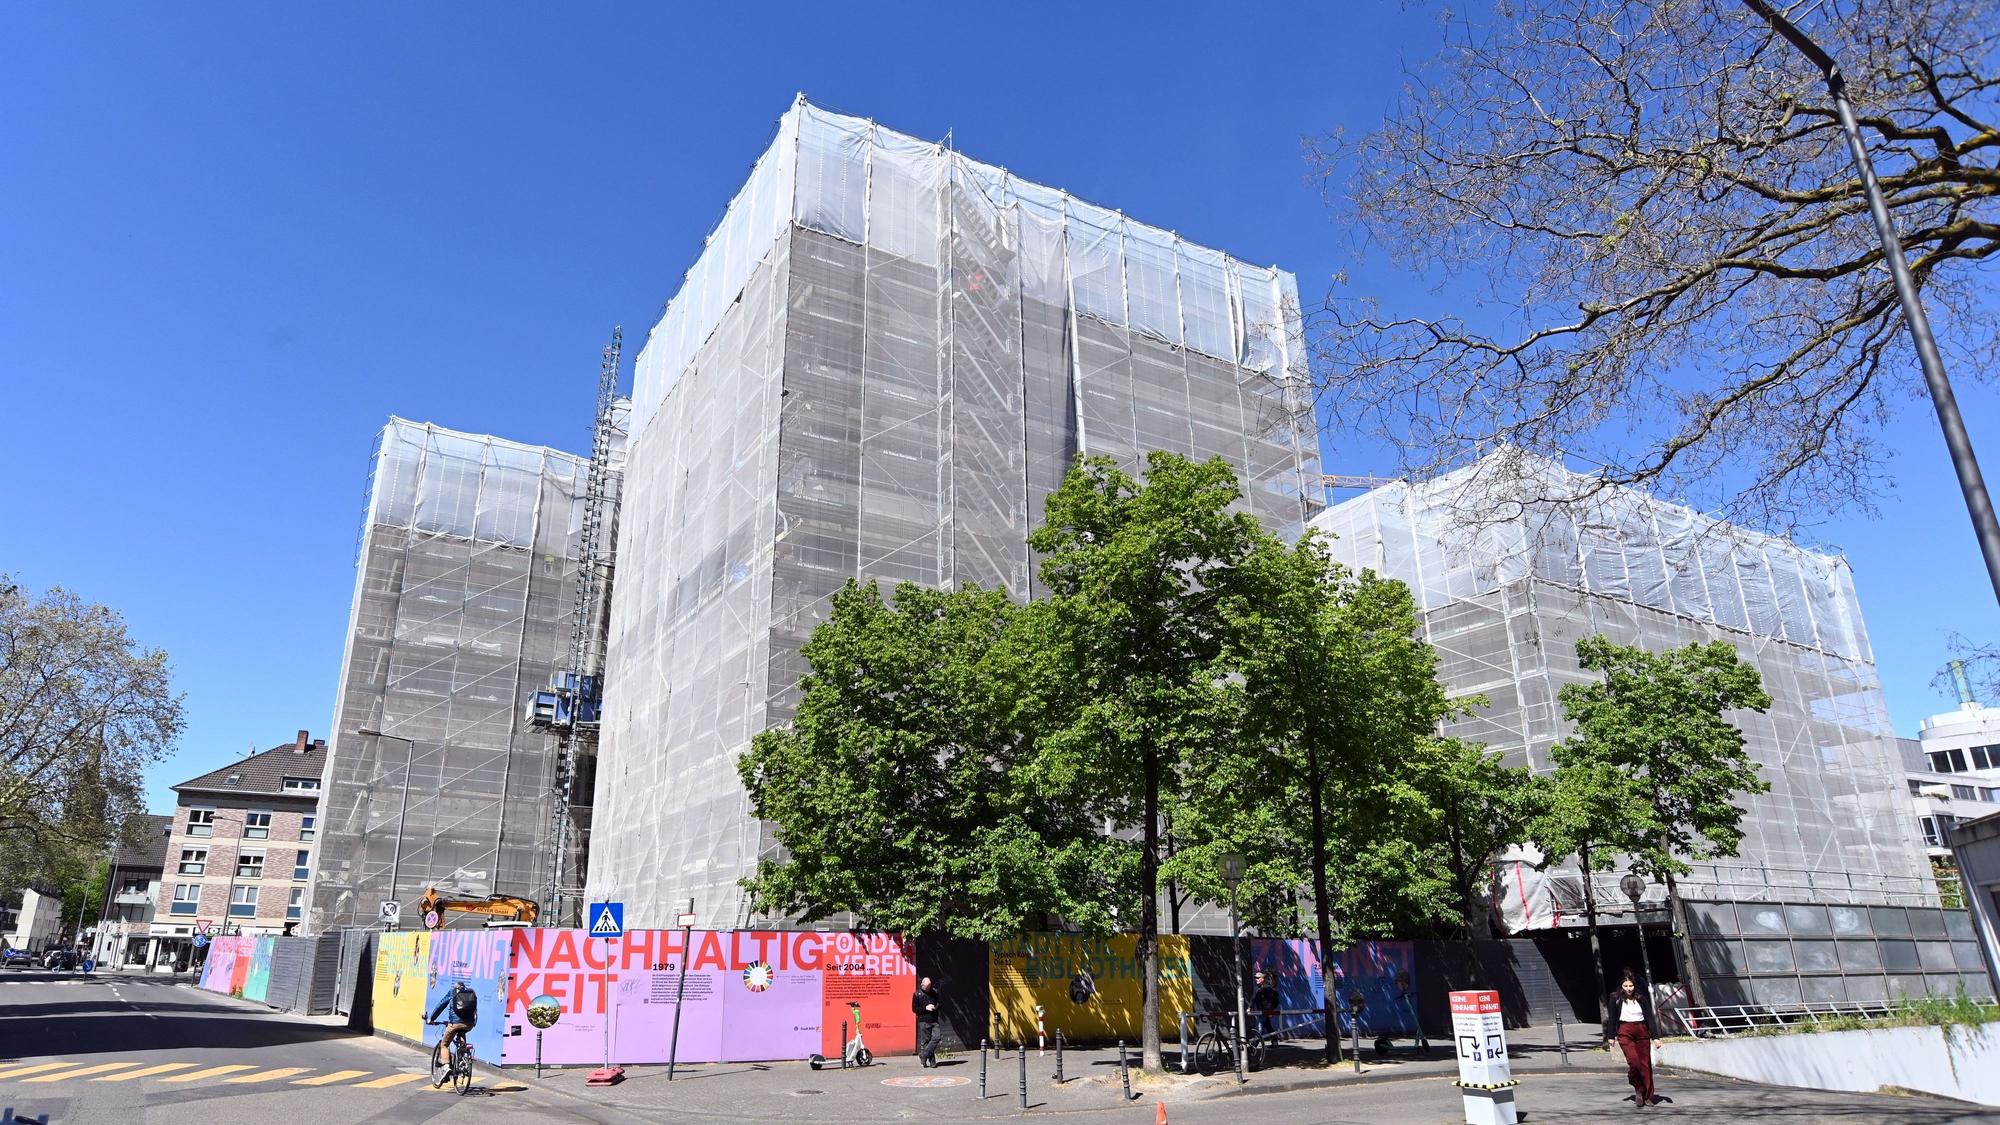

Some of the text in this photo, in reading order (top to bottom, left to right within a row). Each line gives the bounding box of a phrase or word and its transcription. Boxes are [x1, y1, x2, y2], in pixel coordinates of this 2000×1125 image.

[428, 930, 513, 979] ZUKUNFT
[510, 928, 823, 971] NACHHALTIG
[653, 963, 675, 971] 1979
[834, 955, 916, 976] VEREIN
[506, 973, 618, 1014] KEIT
